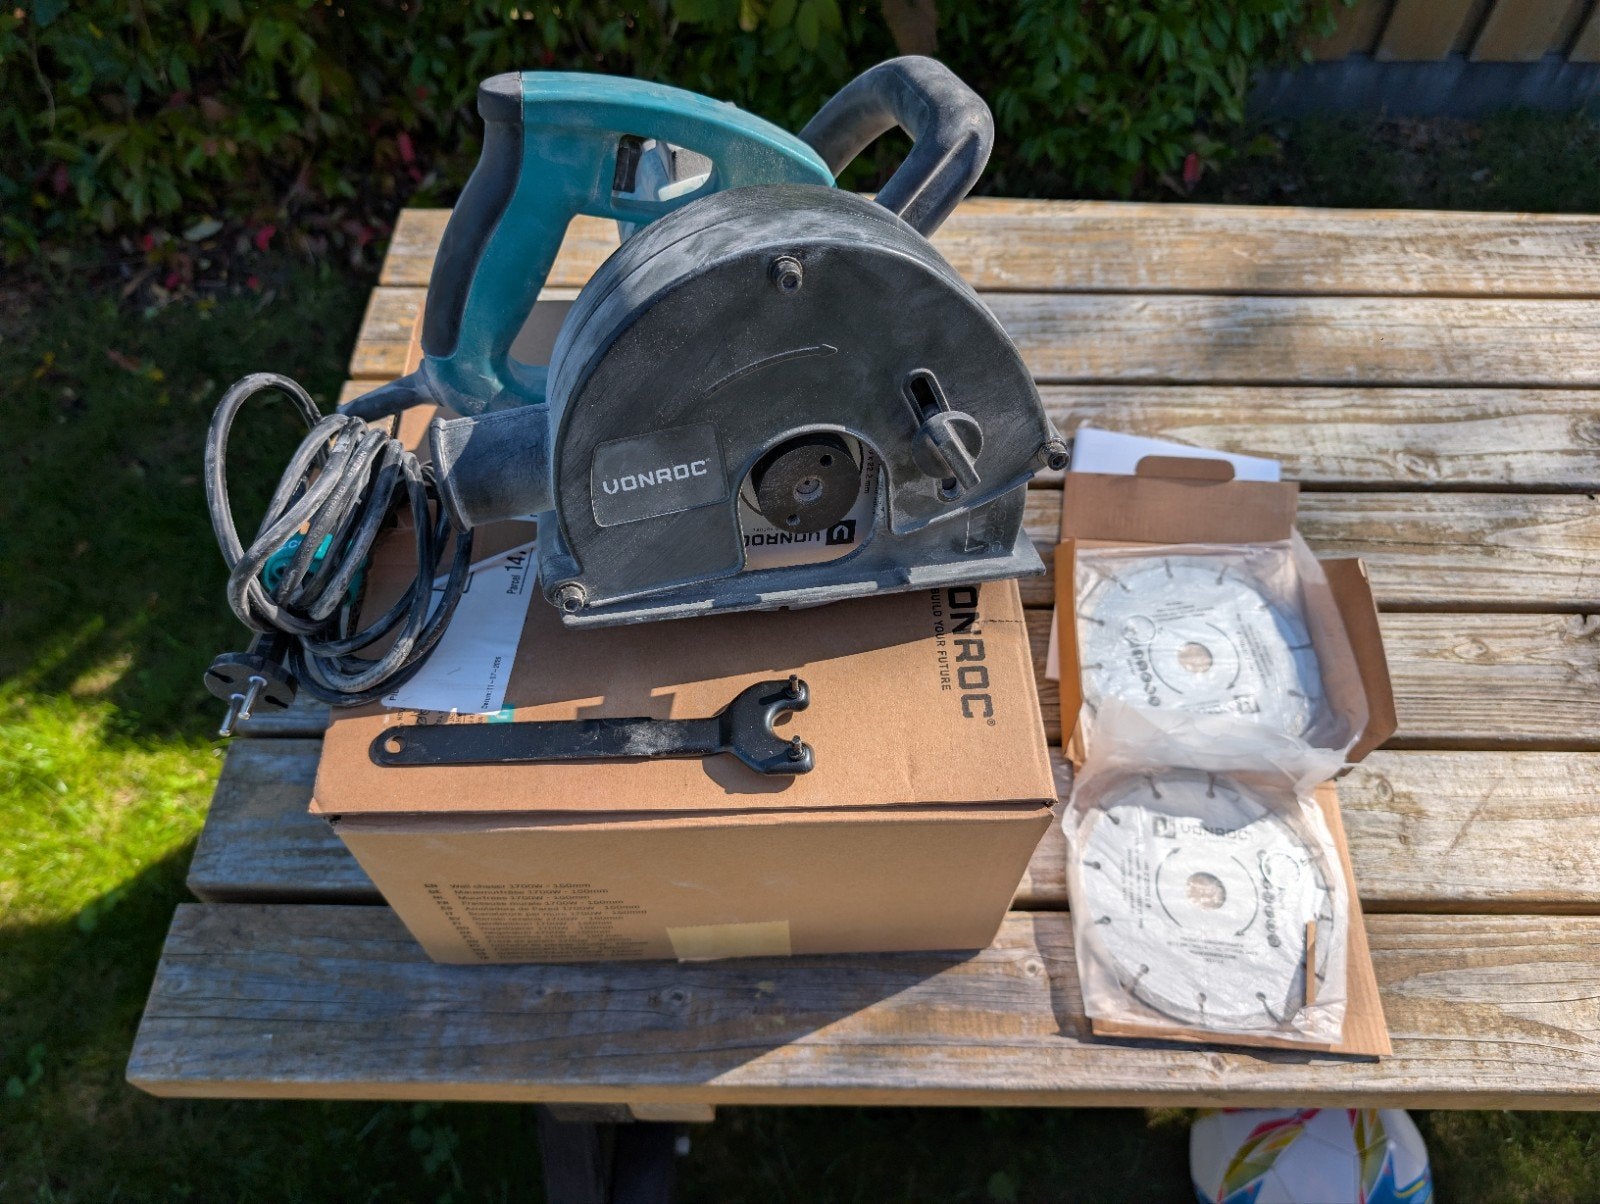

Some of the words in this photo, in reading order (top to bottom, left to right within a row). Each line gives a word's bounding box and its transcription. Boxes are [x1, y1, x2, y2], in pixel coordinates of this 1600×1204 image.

[602, 459, 708, 495] VONROC
[506, 574, 521, 595] Parcel
[931, 588, 942, 617] BUILD
[934, 620, 945, 647] YOUR
[937, 650, 951, 691] FUTURE
